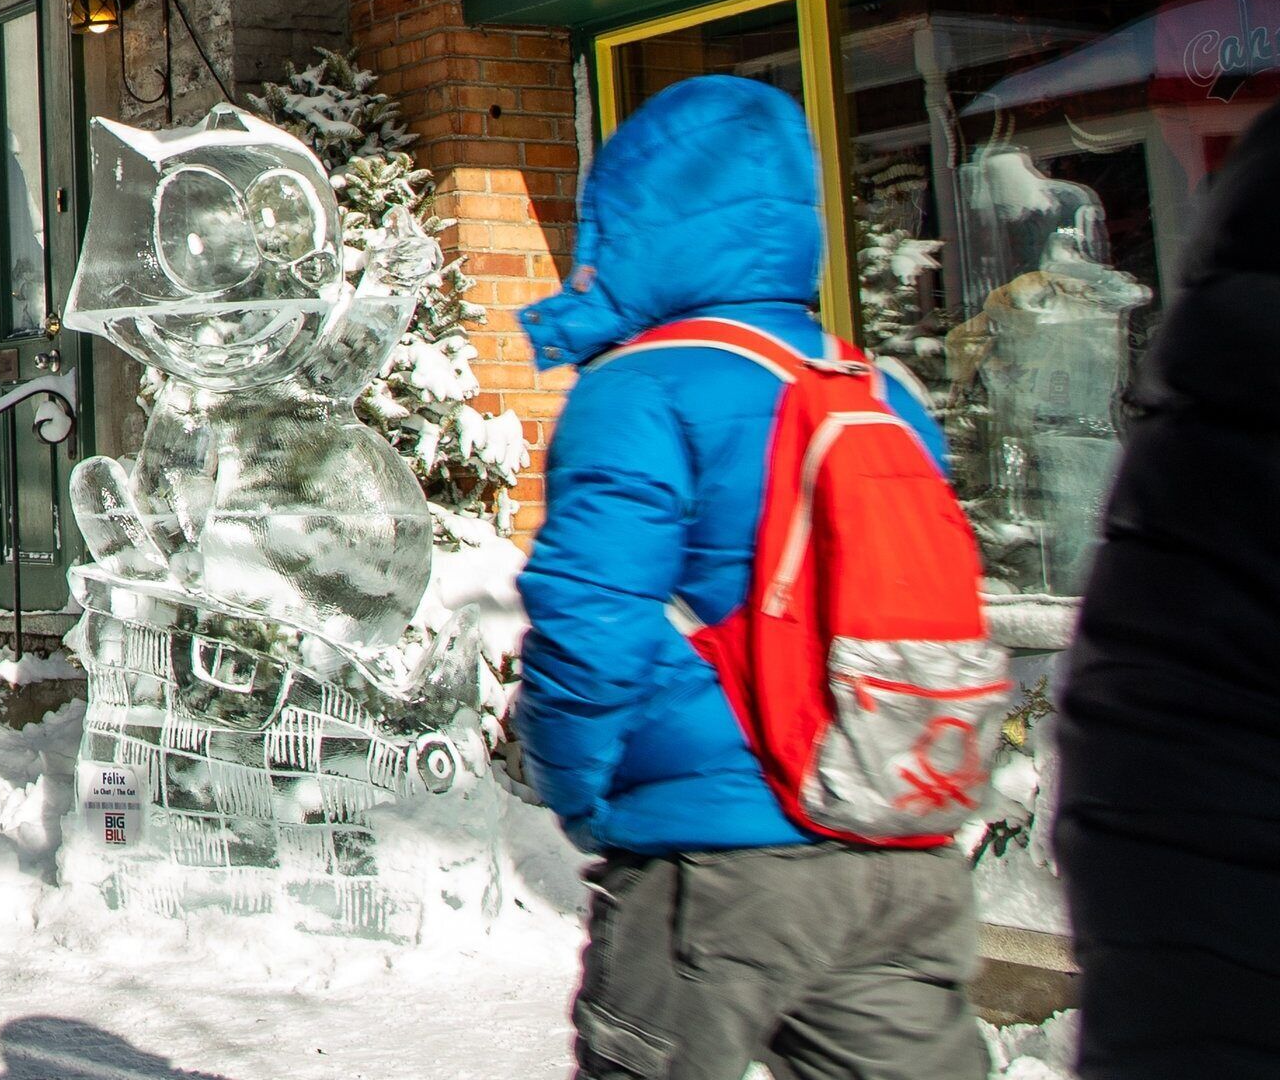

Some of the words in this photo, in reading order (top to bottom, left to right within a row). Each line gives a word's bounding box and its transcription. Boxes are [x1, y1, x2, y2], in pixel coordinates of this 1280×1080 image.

[102, 770, 126, 786] Félix
[127, 788, 136, 796] Cat
[105, 816, 125, 828] BIG
[105, 829, 126, 841] BILL
